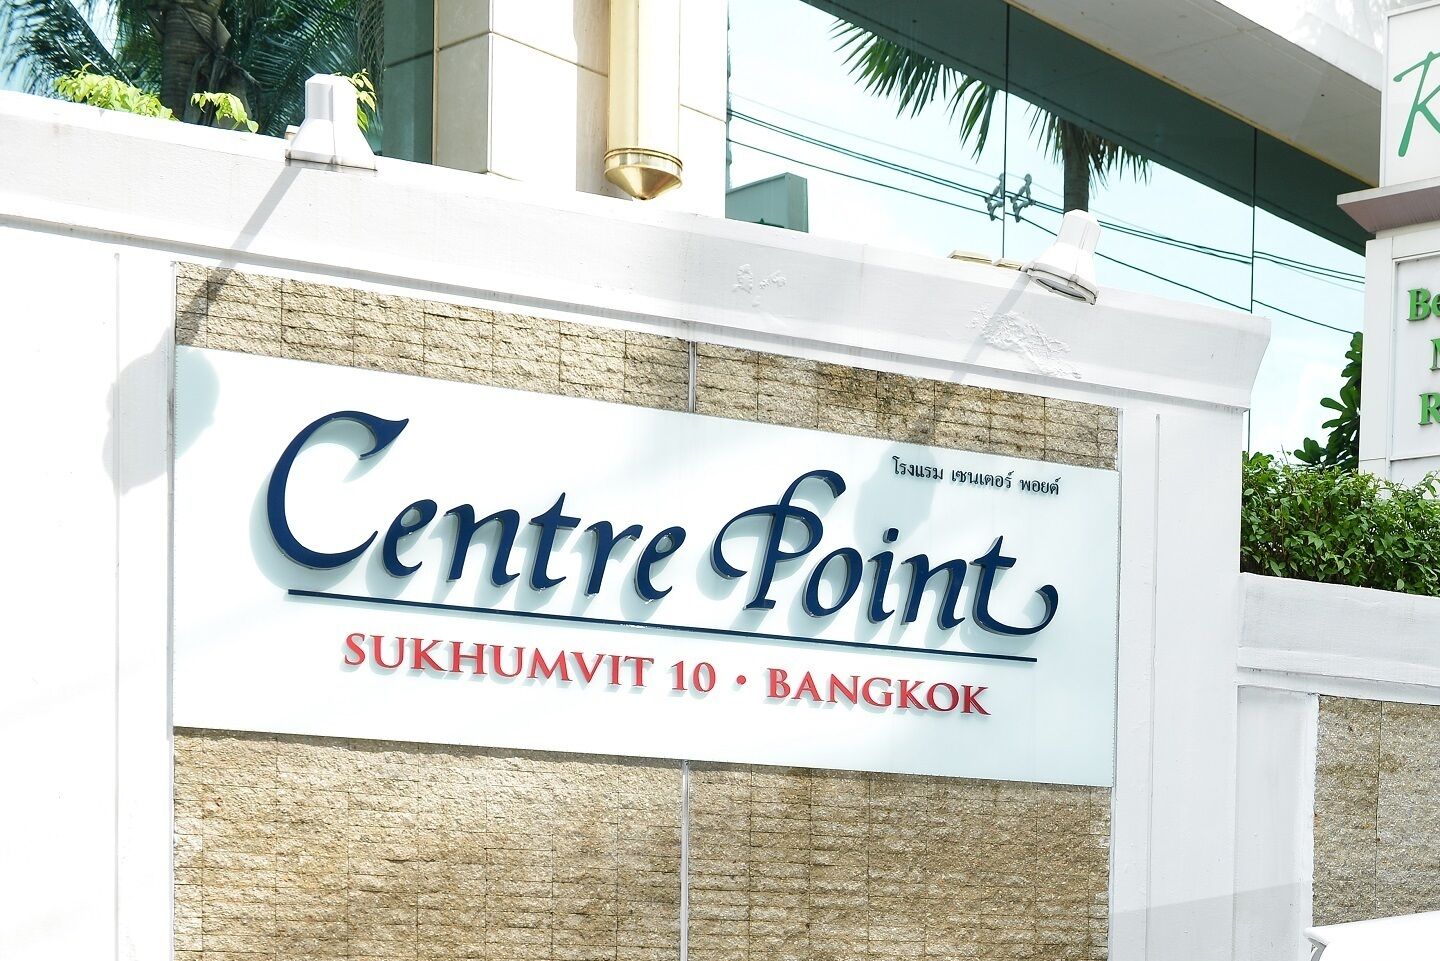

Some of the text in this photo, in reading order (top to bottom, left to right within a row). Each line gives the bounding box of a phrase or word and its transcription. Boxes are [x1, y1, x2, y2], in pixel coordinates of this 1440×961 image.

[892, 455, 1062, 496] โรงแรม เซนเตอร์ พอยต์
[267, 411, 1060, 637] Centre Point
[343, 633, 993, 717] SUKHUMVIT 10 BANGKOK
